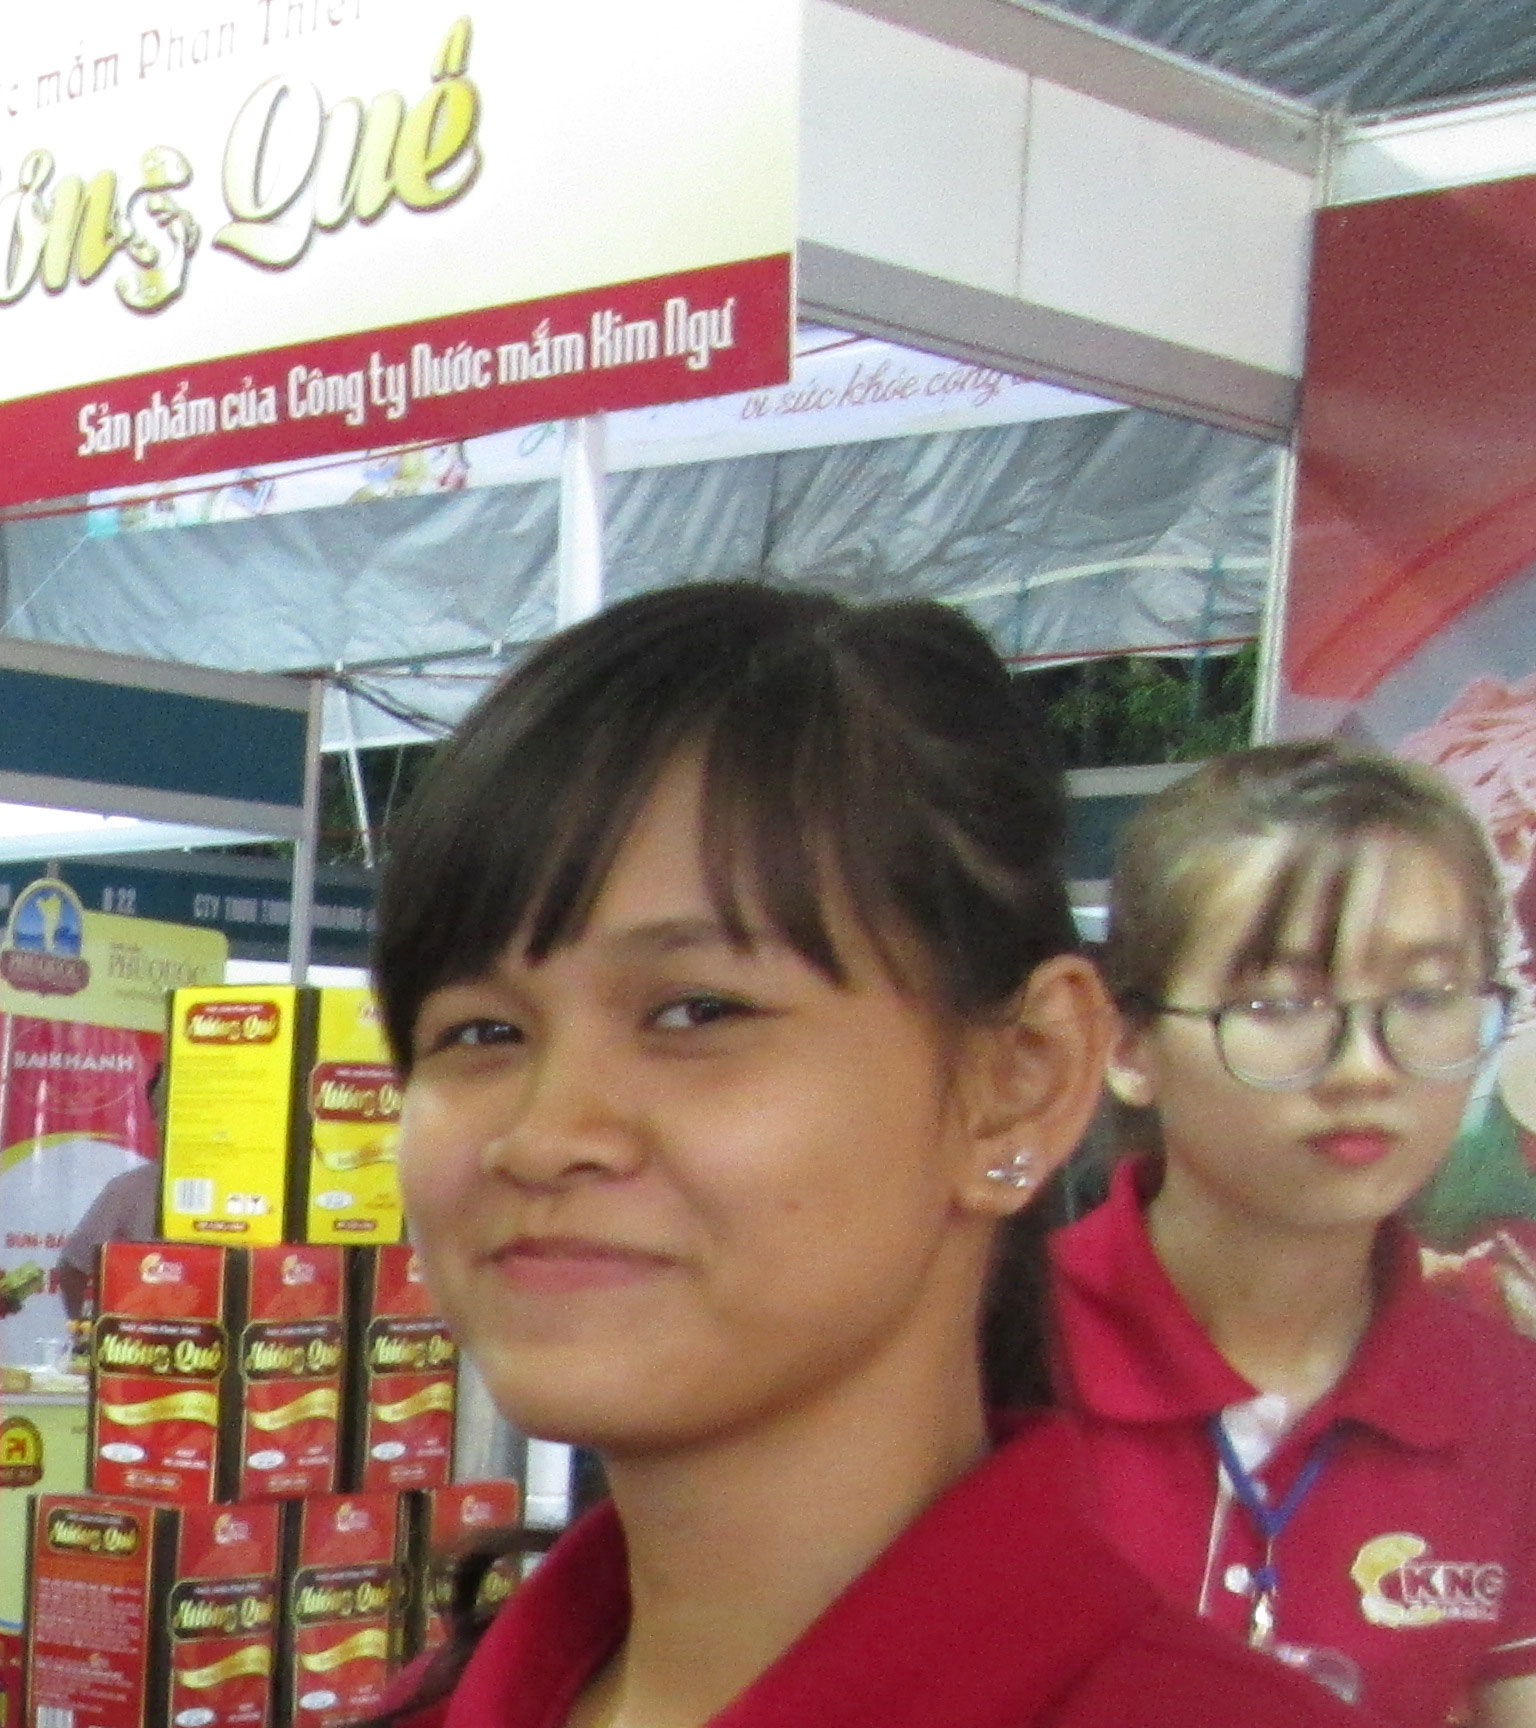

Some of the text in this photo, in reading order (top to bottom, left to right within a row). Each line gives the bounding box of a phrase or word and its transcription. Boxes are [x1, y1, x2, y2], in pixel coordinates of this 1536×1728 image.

[257, 0, 362, 46] Thi
[77, 296, 737, 461] Sản phẩm của Công ty Nước mắm Kim Ngư
